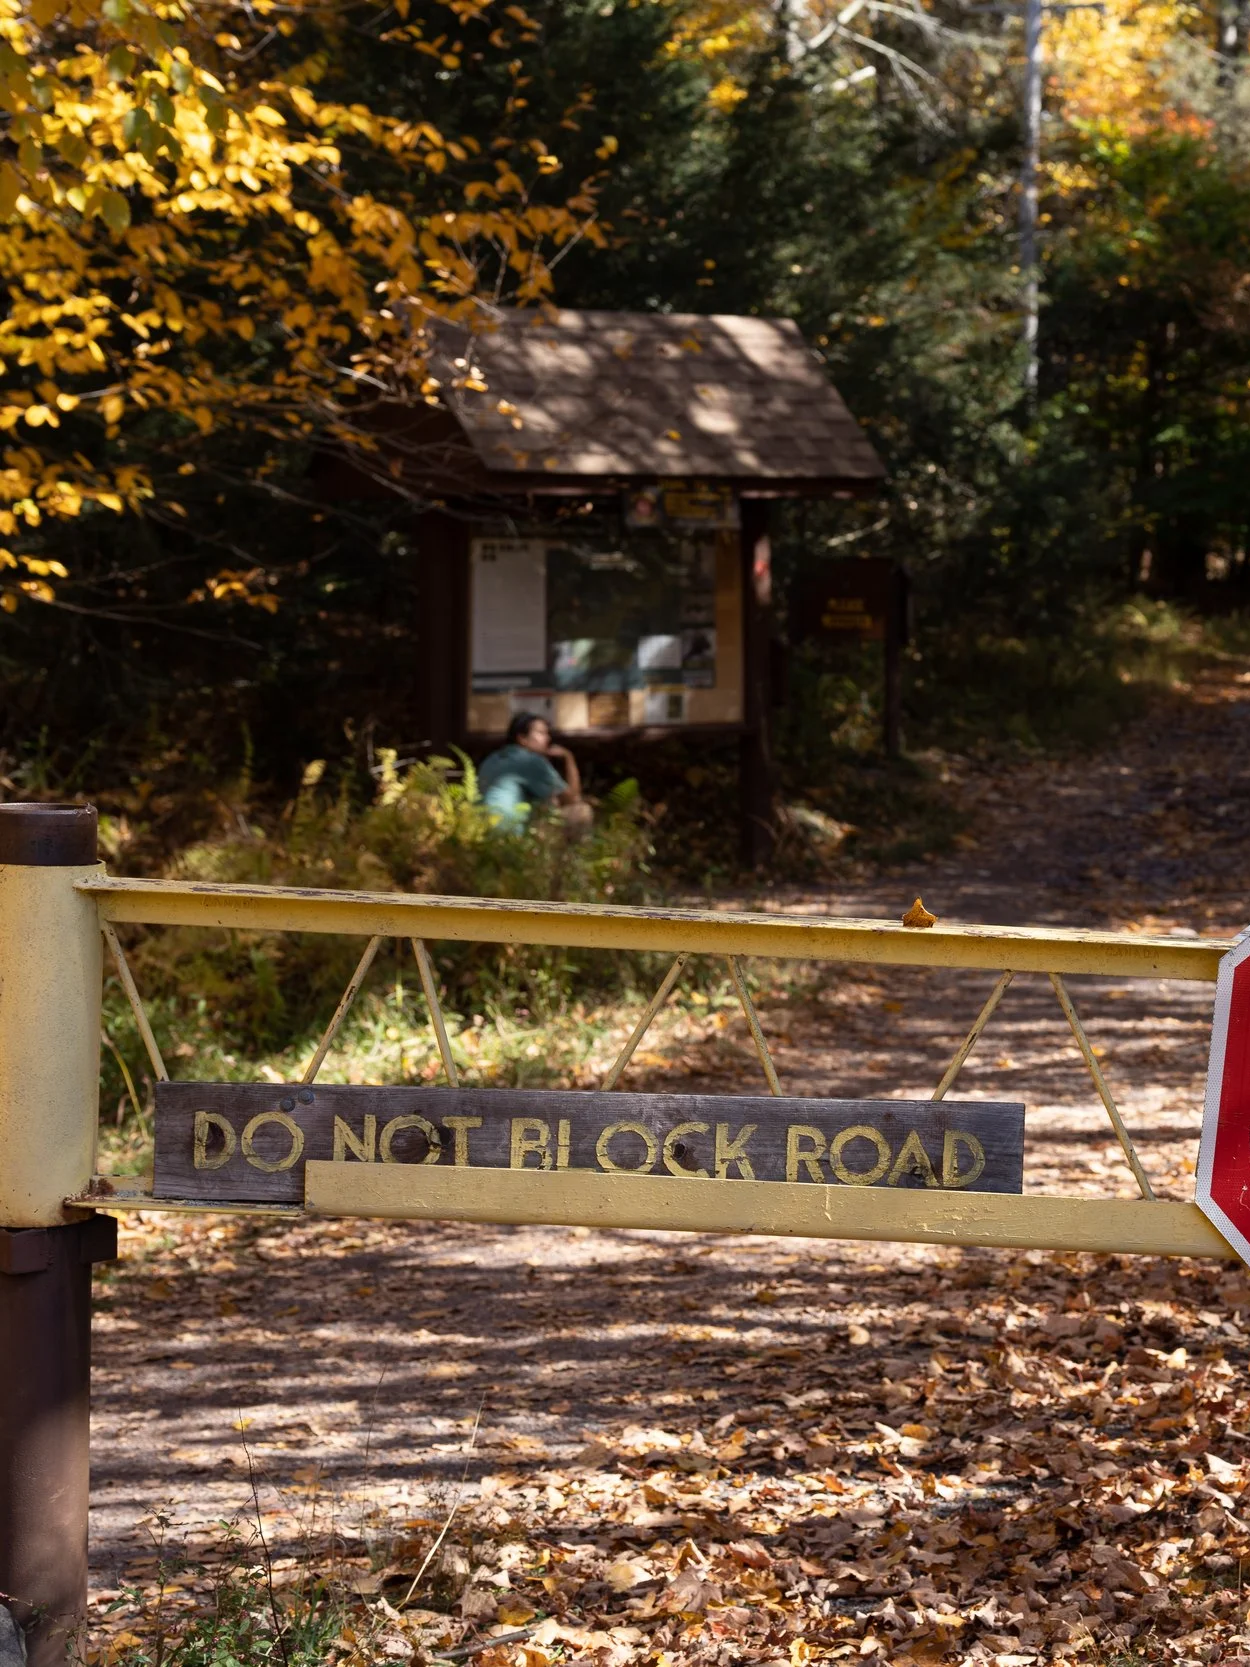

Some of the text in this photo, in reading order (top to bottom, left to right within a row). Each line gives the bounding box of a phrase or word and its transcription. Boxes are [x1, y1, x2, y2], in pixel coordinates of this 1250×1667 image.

[194, 1112, 986, 1188] DO NOT BLOCK ROAD
